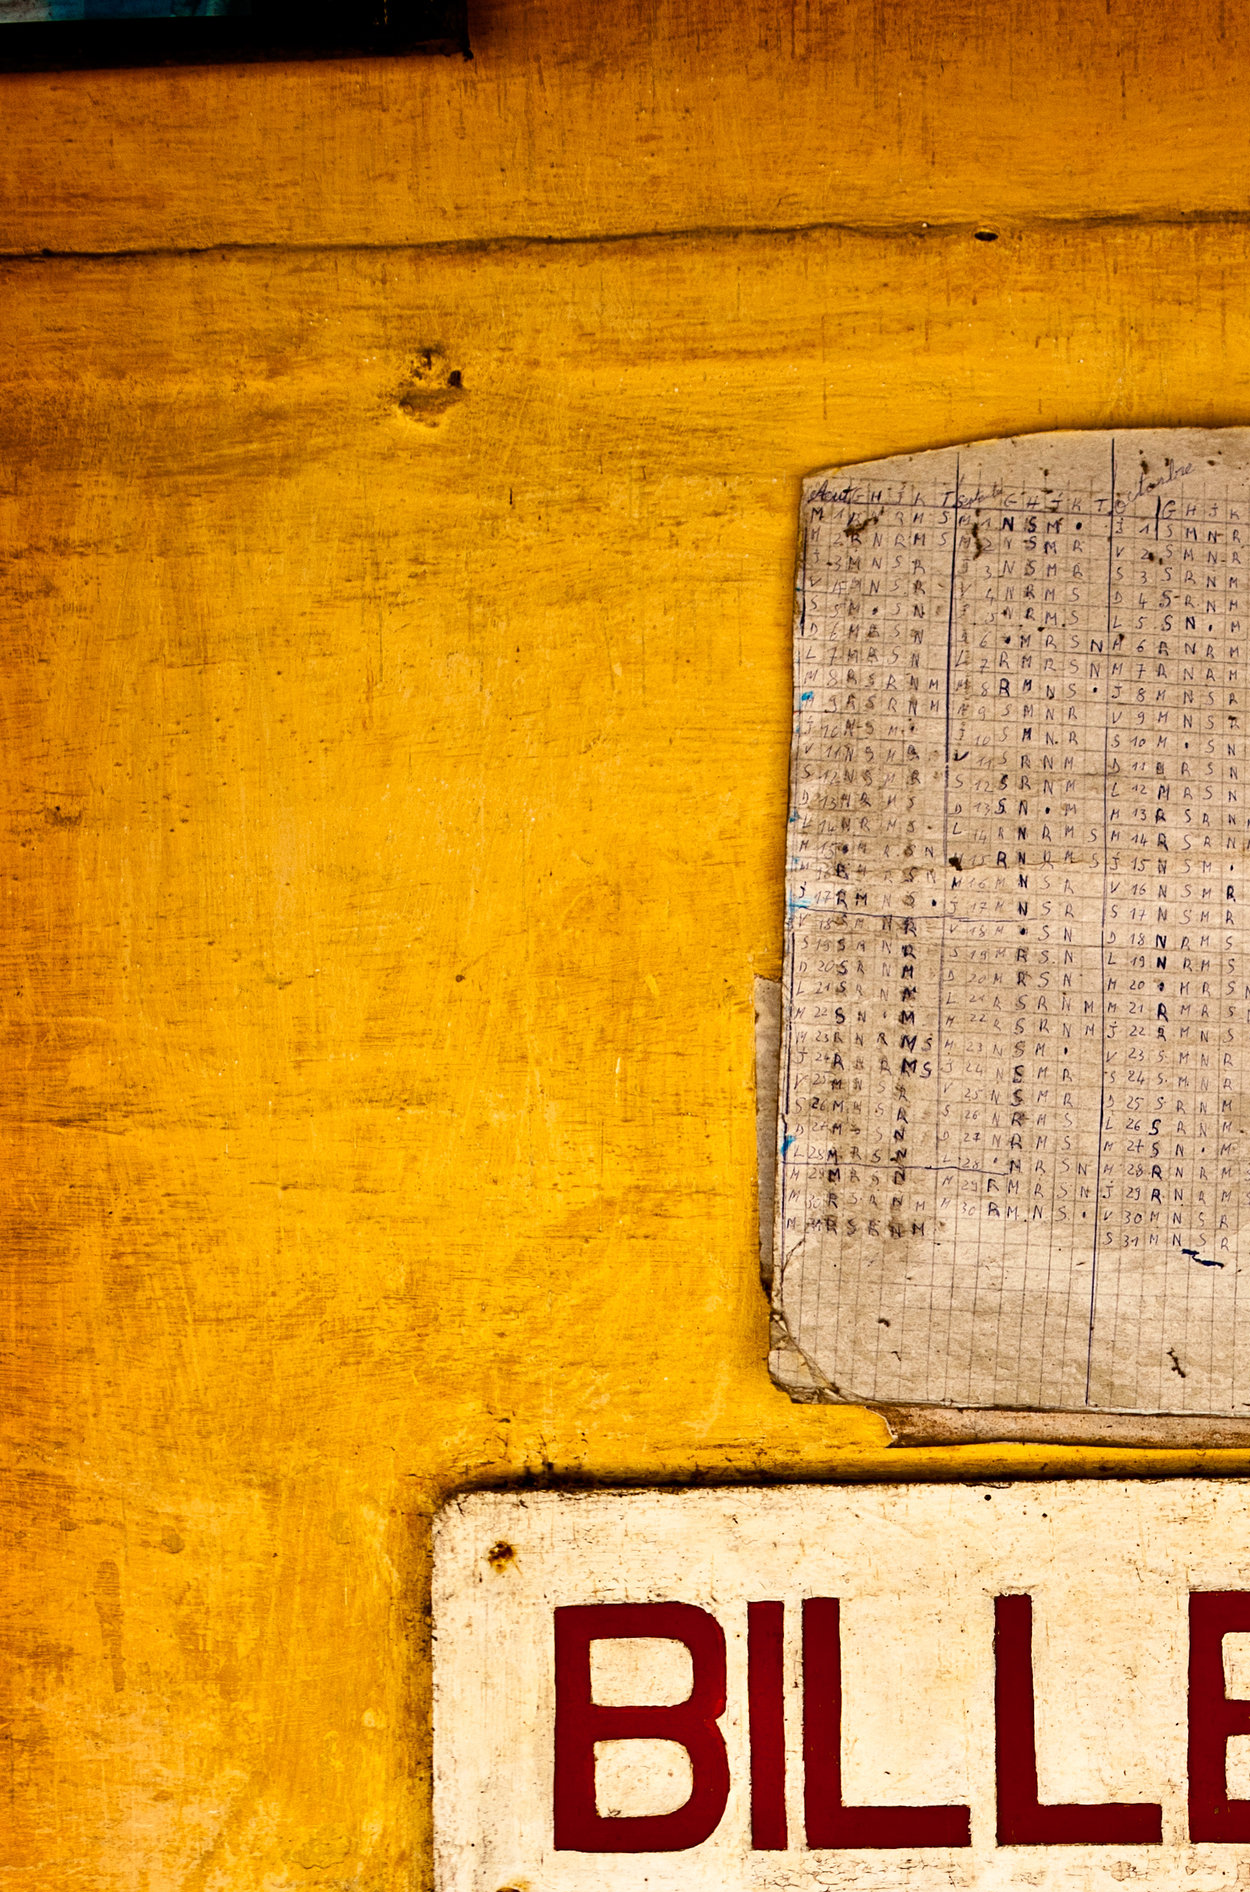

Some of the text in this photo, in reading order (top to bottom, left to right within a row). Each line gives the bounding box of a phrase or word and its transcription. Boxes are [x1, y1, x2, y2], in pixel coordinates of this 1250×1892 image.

[1162, 500, 1176, 519] G
[1186, 504, 1197, 516] H
[1113, 616, 1122, 629] L
[1135, 616, 1148, 630] 5
[806, 647, 817, 660] L
[827, 647, 838, 664] 7
[889, 650, 899, 664] S
[980, 682, 989, 697] 8
[1067, 683, 1077, 698] S
[1111, 905, 1118, 919] S
[1130, 908, 1146, 922] 17
[1179, 909, 1193, 926] S
[818, 960, 834, 973] 20
[837, 960, 848, 976] S
[967, 975, 987, 985] 20
[1040, 972, 1050, 988] S
[1129, 1002, 1144, 1015] 21
[1228, 1006, 1237, 1018] S
[964, 1132, 981, 1143] 27
[1062, 1136, 1072, 1151] S
[847, 1219, 858, 1238] S
[1103, 1232, 1113, 1246] S
[1123, 1235, 1139, 1248] 31
[1196, 1233, 1207, 1248] S
